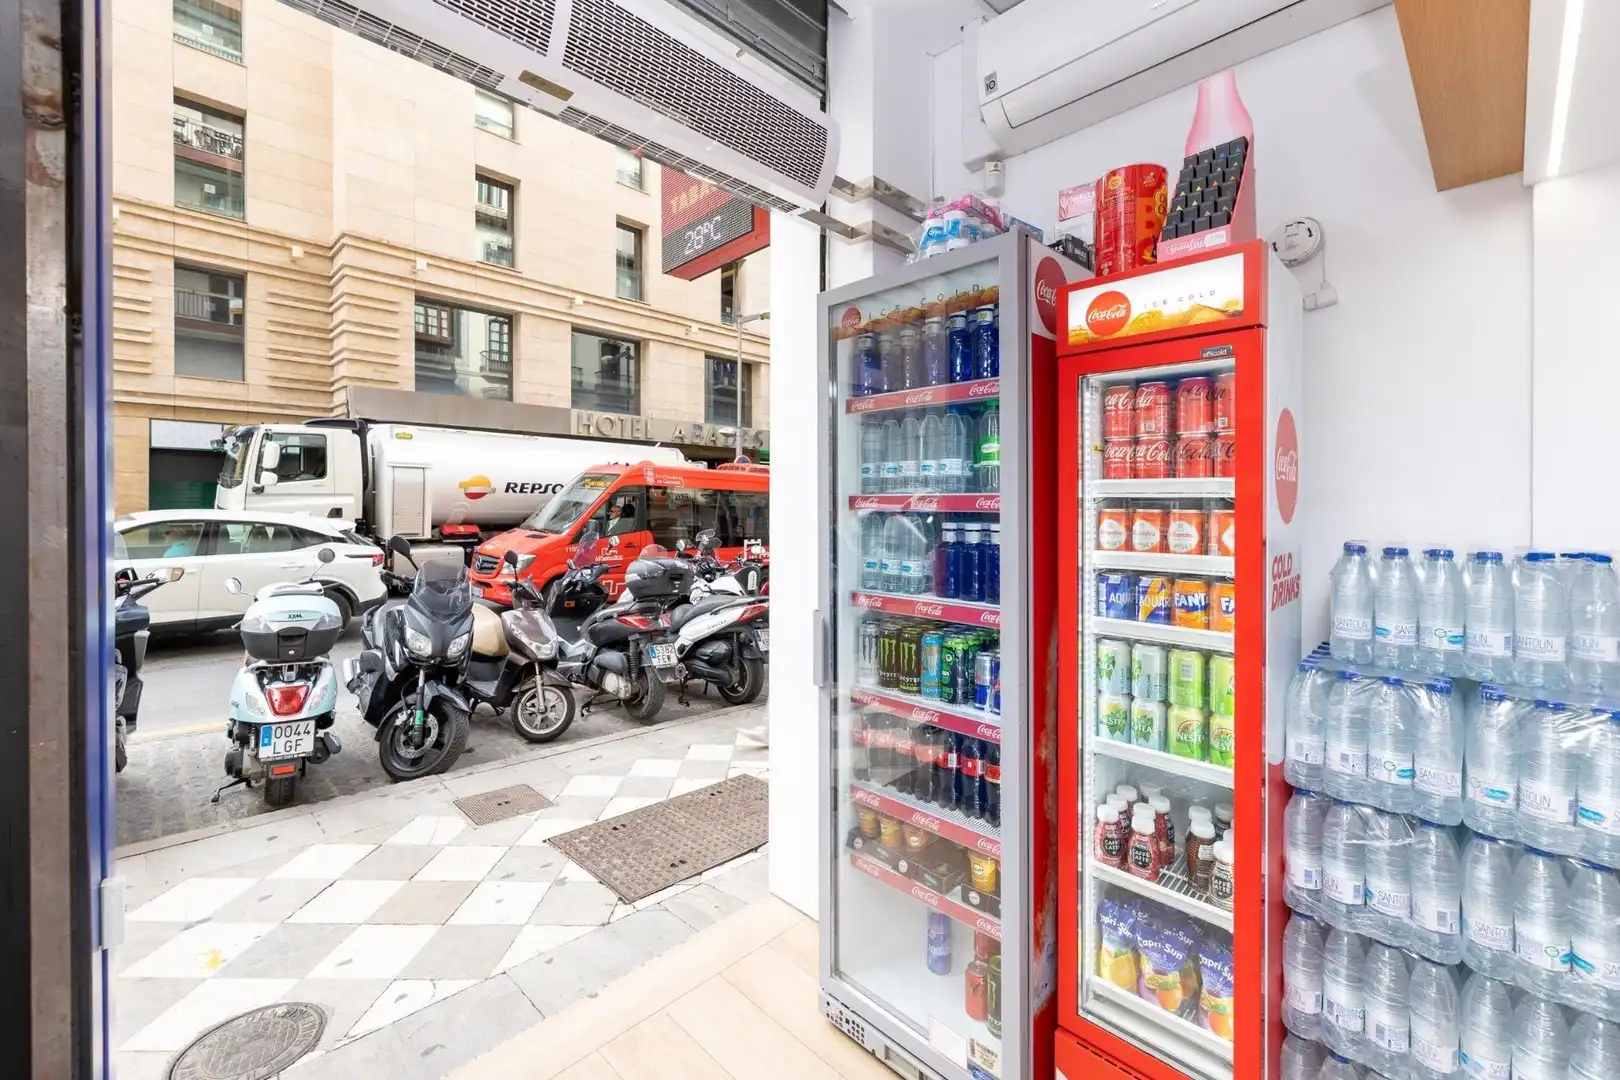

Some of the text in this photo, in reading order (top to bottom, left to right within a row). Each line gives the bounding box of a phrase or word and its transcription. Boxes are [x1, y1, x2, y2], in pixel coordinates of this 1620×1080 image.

[1143, 290, 1217, 309] ICE COLD
[1088, 303, 1128, 323] Coca-Cola
[577, 411, 654, 440] HOTEL
[504, 481, 565, 495] REPSO
[1272, 552, 1293, 581] COLD
[1174, 592, 1208, 607] FANT
[1271, 573, 1301, 612] DRINKS
[274, 722, 312, 740] 0044
[272, 738, 303, 755] LGF
[1136, 934, 1184, 960] Capri-Sun
[1198, 953, 1234, 983] Capri-Su
